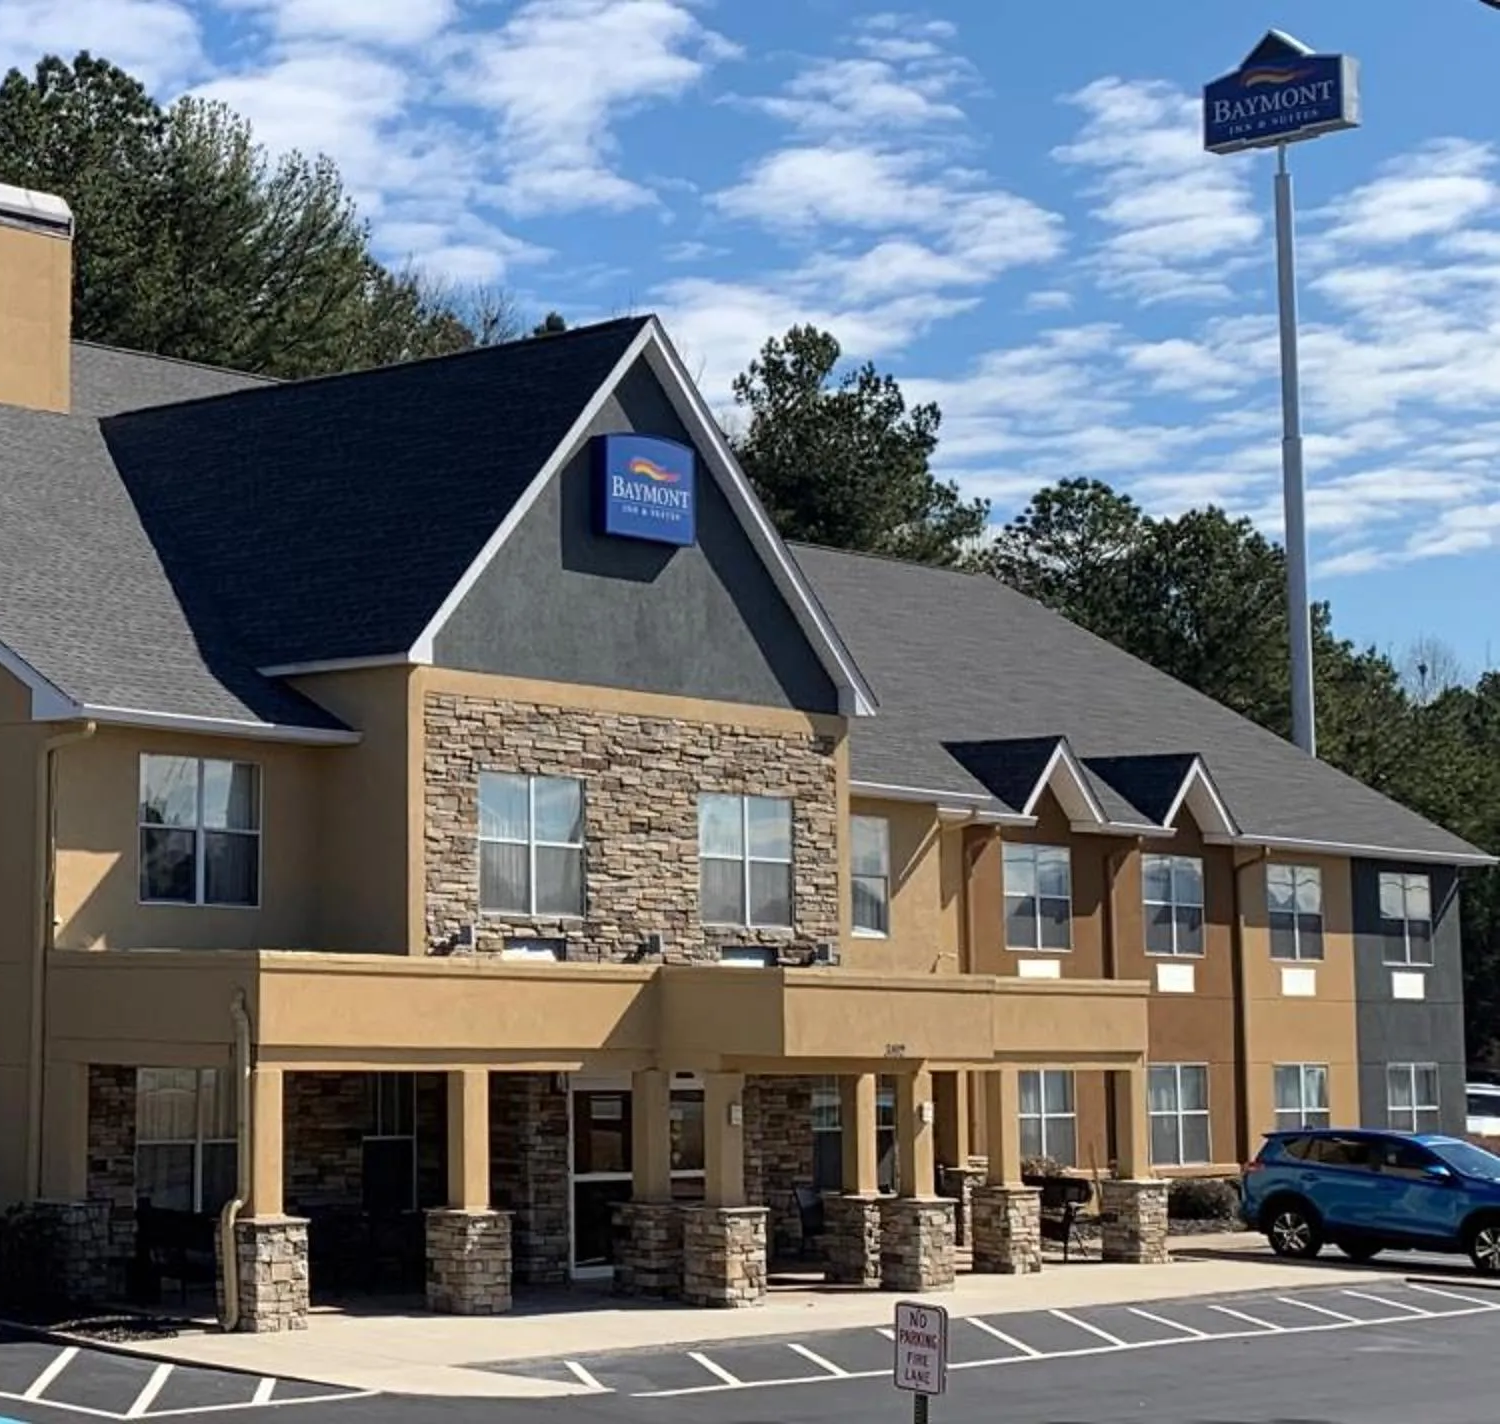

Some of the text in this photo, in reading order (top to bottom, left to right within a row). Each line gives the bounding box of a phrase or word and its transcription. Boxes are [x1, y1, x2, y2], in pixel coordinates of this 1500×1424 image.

[1213, 79, 1335, 123] BAYMONT
[611, 475, 690, 509] BAYMONT
[909, 1311, 928, 1329] NO
[899, 1329, 938, 1350] PARKING
[907, 1351, 929, 1367] FIRE
[905, 1367, 931, 1385] LANE
